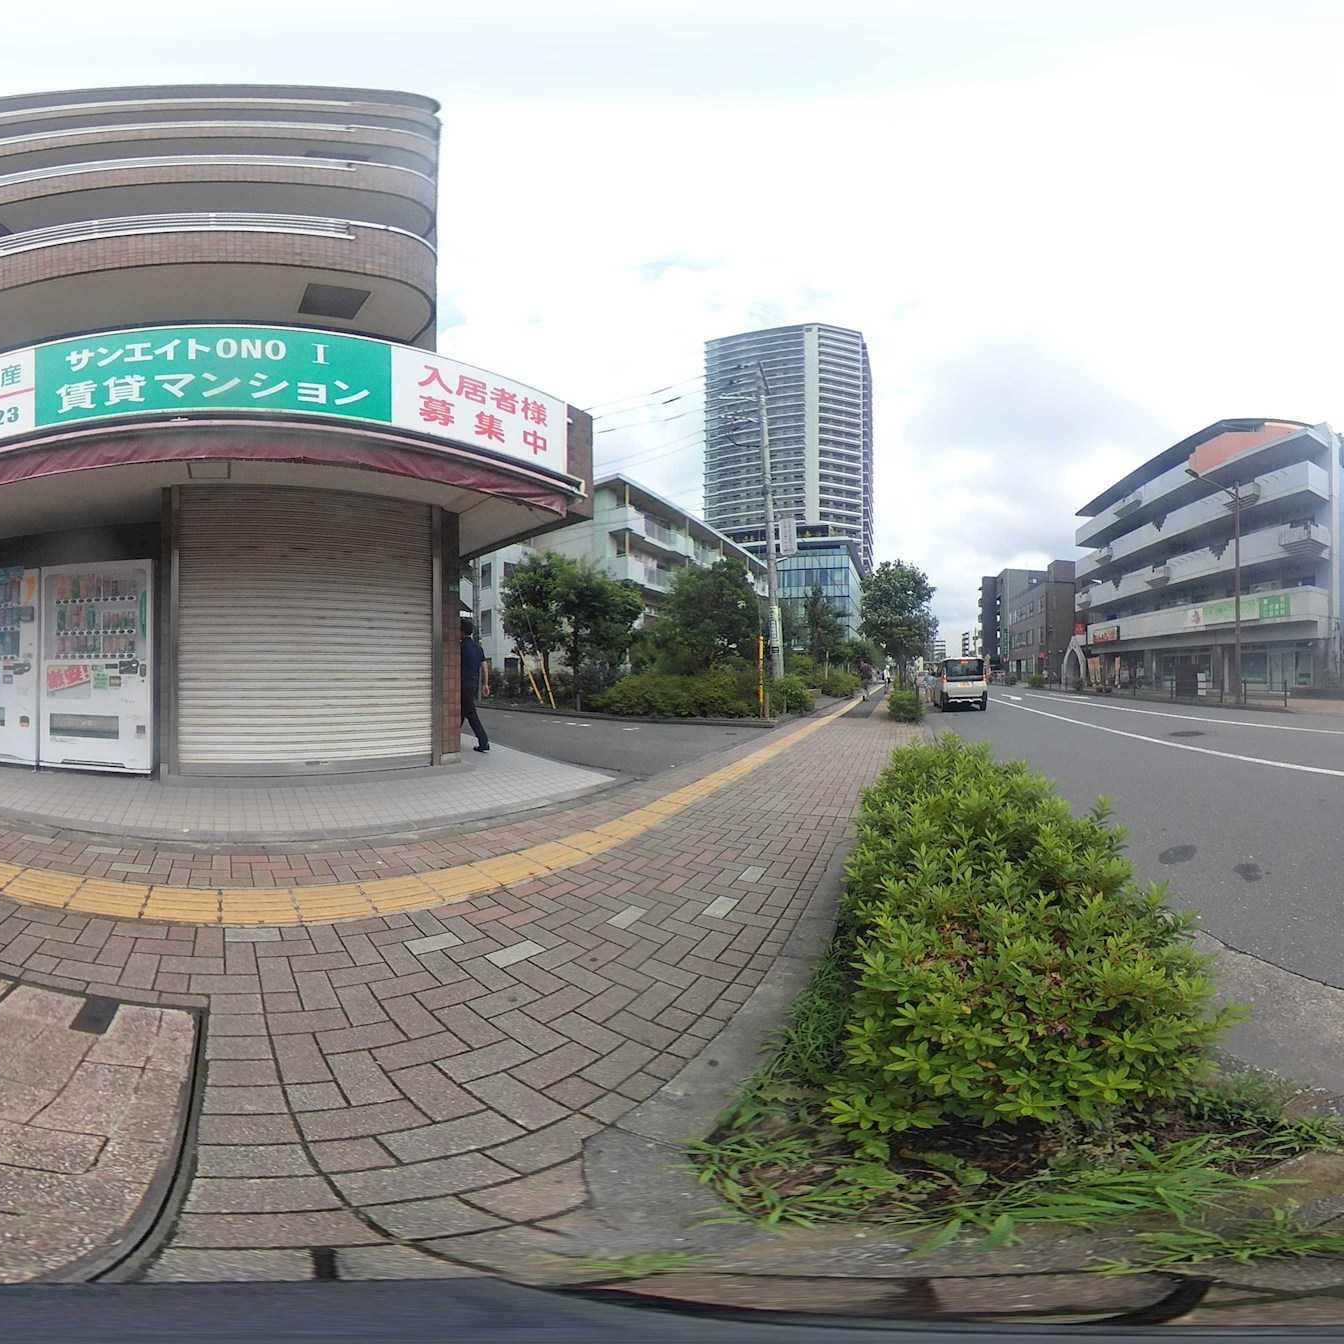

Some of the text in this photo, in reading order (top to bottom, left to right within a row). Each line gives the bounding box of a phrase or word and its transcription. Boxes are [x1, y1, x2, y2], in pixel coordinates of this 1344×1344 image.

[65, 338, 287, 372] サンエイトONO
[56, 374, 370, 414] 賃貸マンション
[418, 365, 547, 427] 入居者様
[419, 395, 547, 455] 募集中
